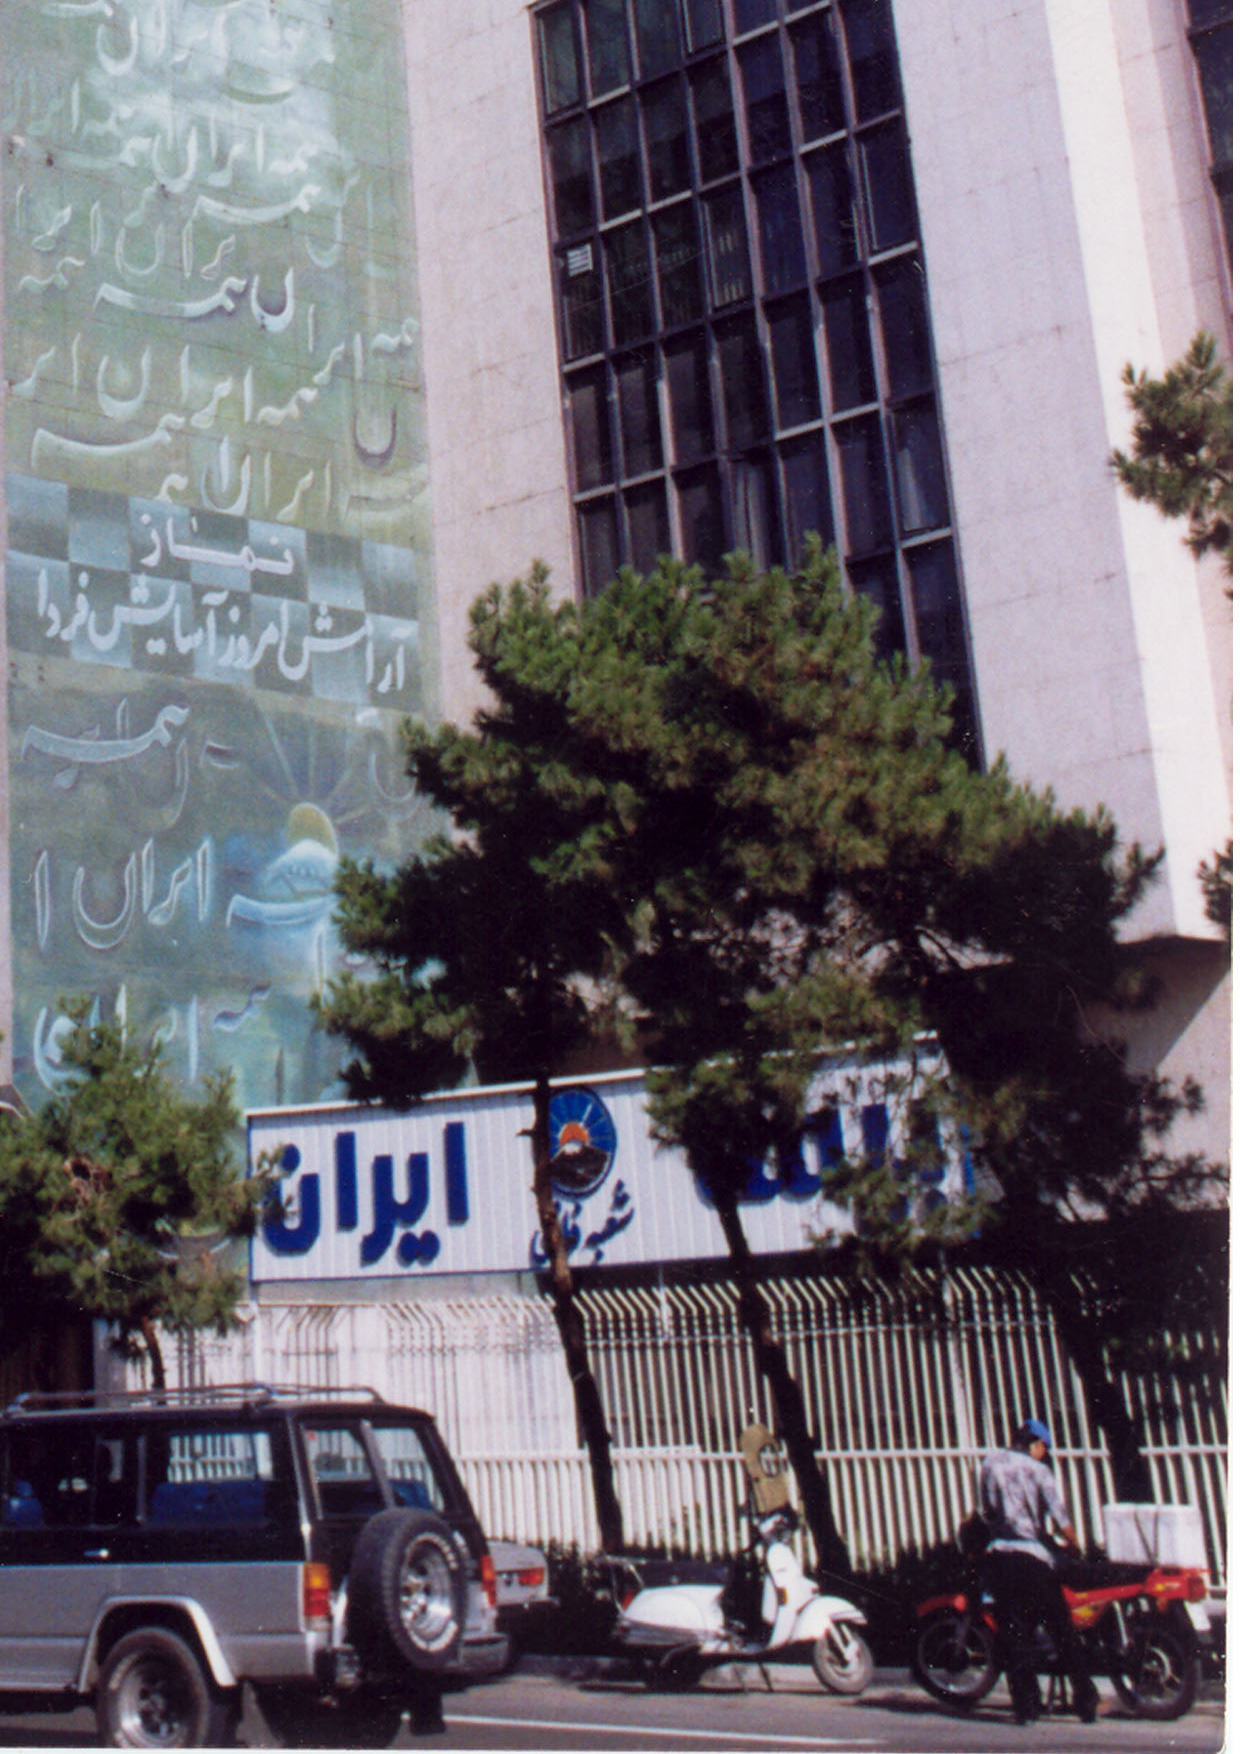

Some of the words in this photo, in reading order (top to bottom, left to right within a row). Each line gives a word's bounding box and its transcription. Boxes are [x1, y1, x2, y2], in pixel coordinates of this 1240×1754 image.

[37, 567, 90, 642] فردا
[87, 571, 229, 658] آسایش
[218, 600, 292, 670] امروز
[277, 600, 412, 695] آرامش
[261, 1120, 467, 1265] ایران
